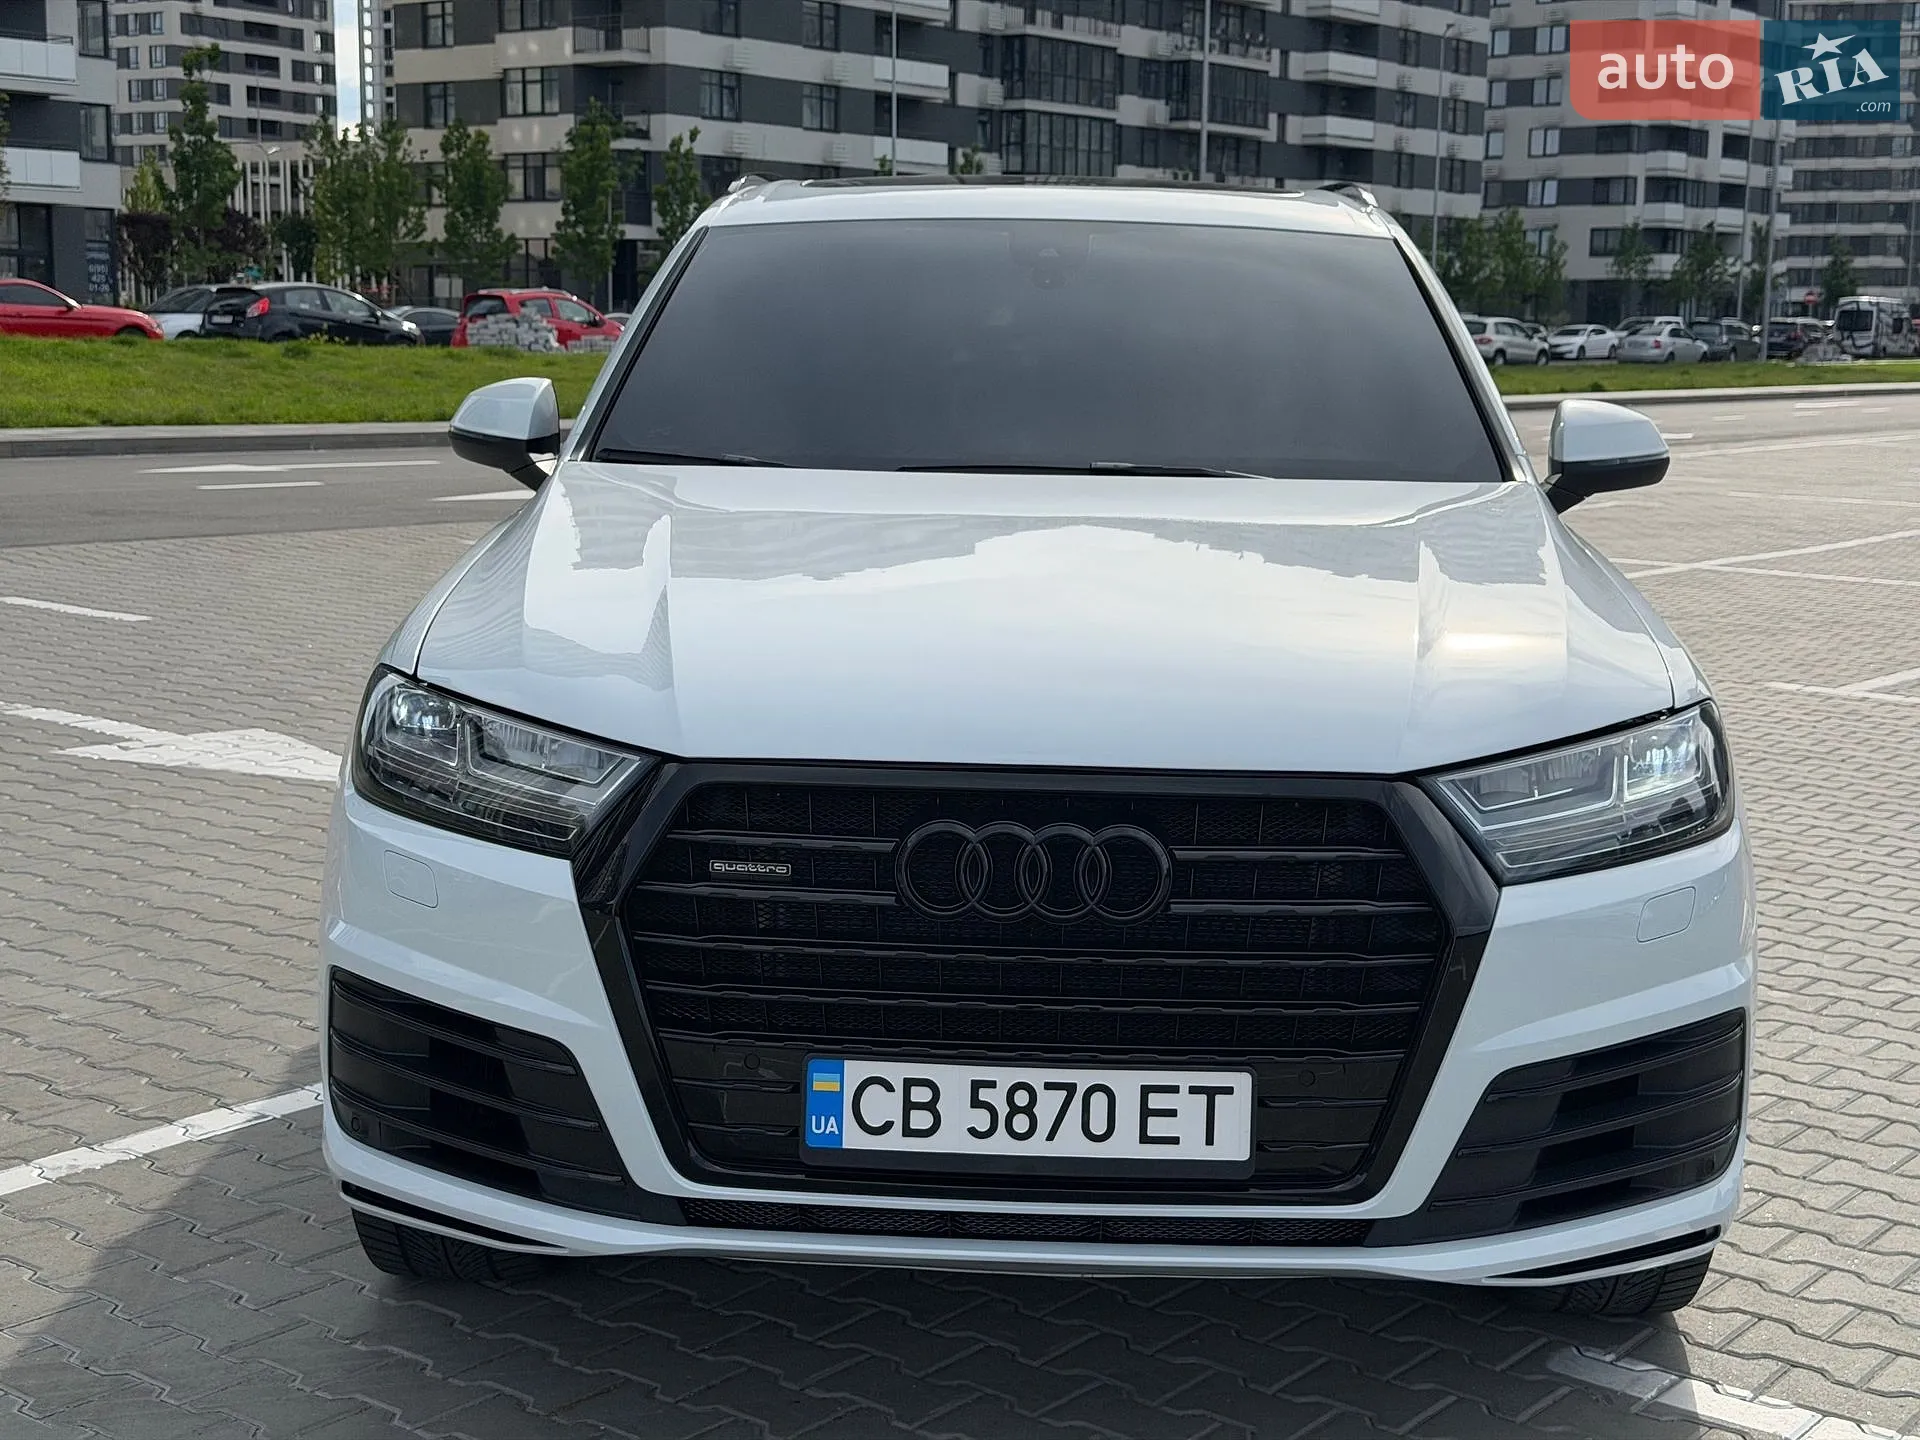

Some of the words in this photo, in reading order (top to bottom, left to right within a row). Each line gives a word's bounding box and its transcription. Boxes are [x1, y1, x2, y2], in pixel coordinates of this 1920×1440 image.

[713, 862, 788, 874] quattro
[851, 1075, 943, 1139] CB
[966, 1078, 1117, 1143] 5870
[1138, 1084, 1236, 1147] ET
[811, 1115, 840, 1135] UA
